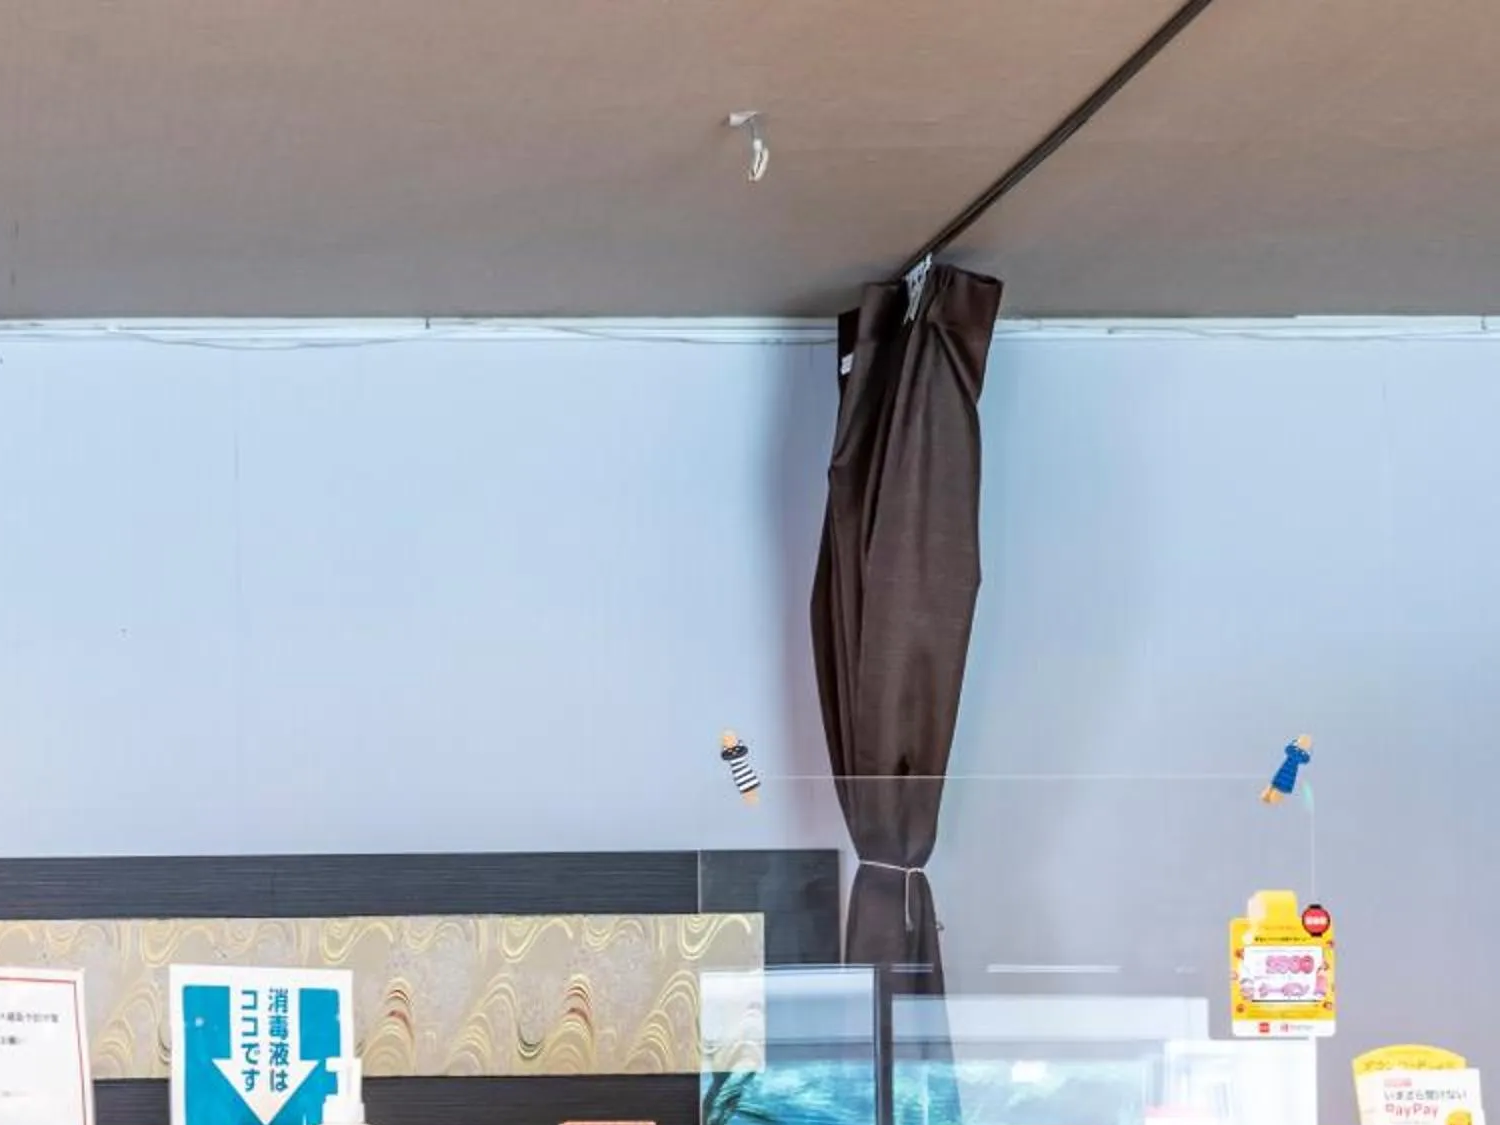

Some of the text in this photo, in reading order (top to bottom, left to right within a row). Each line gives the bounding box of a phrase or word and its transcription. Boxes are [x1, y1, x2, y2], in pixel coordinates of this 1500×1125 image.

[241, 989, 260, 1092] ココです
[268, 987, 289, 1092] 消毒液は
[1385, 1103, 1438, 1117] PayPay
